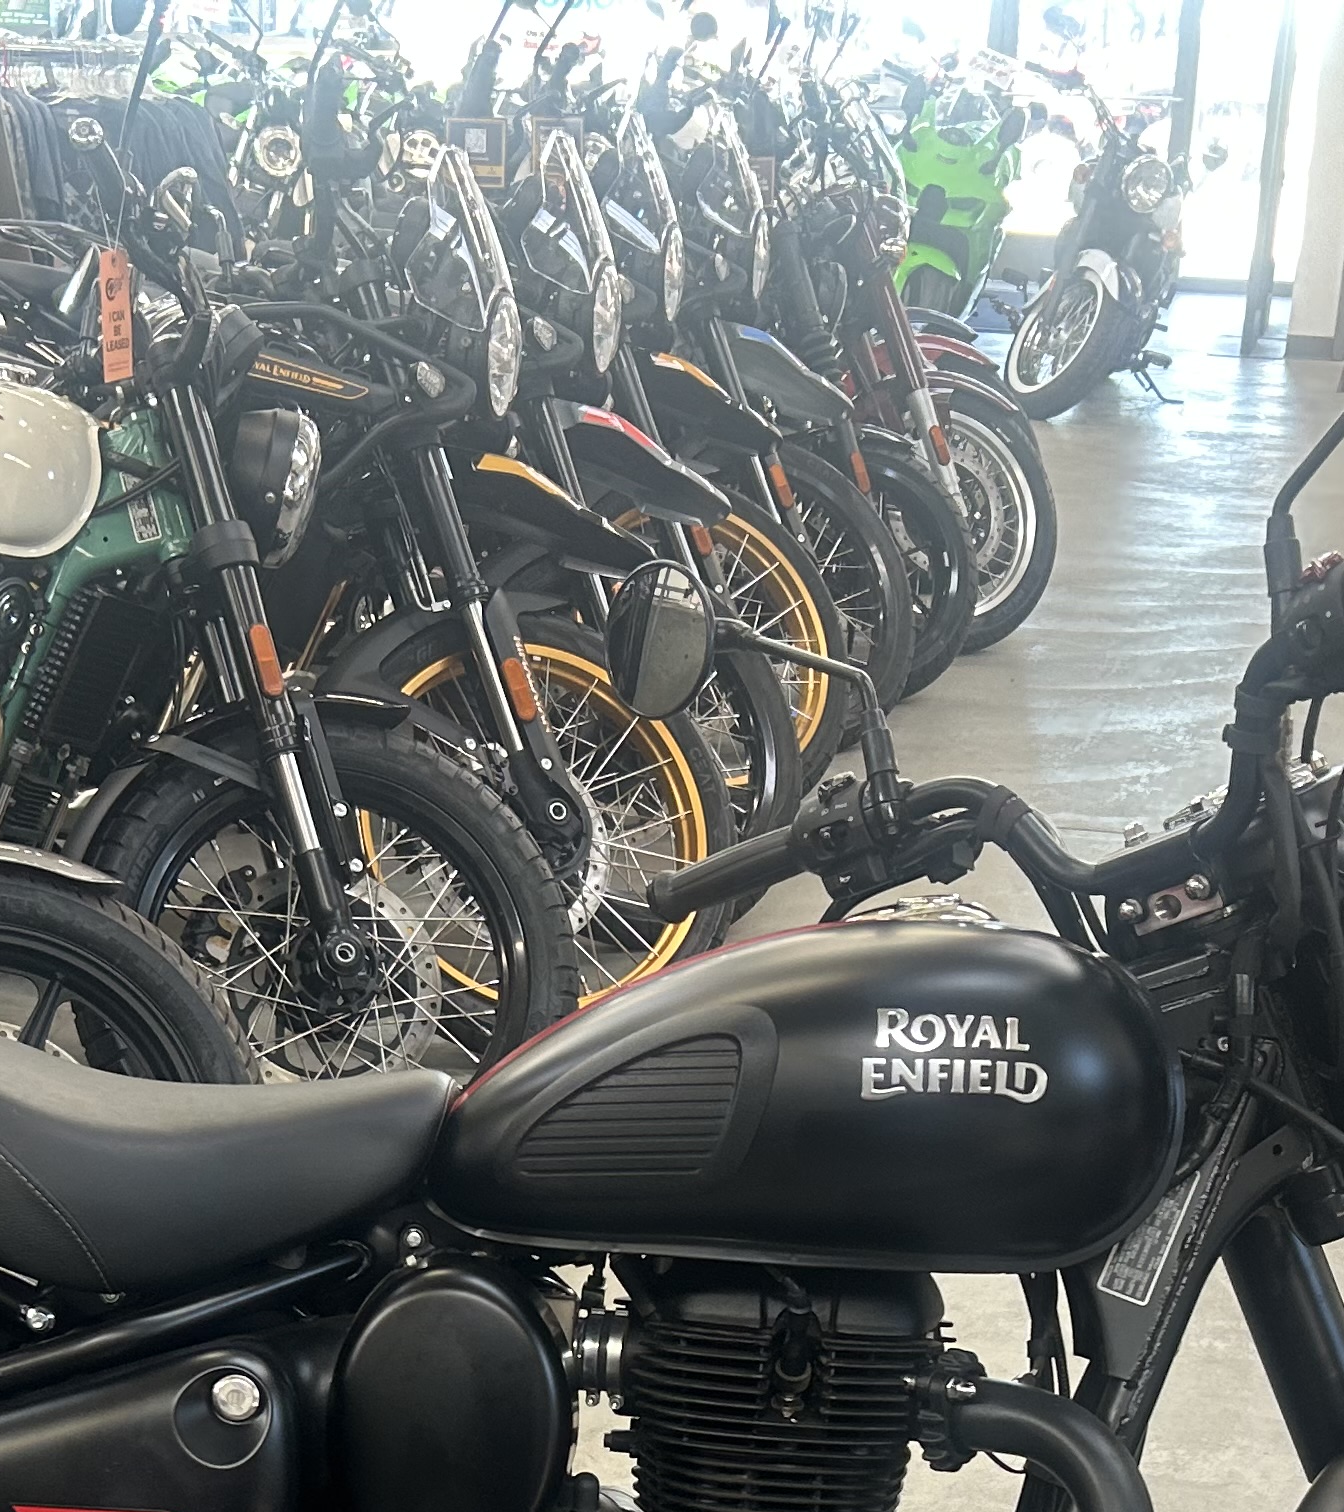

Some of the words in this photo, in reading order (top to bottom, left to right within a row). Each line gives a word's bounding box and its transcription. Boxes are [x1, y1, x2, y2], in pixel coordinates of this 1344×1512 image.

[106, 338, 130, 352] LEASED
[114, 325, 122, 336] BE
[875, 1007, 1031, 1053] ROYAL
[860, 1056, 1049, 1104] ENFIELD
